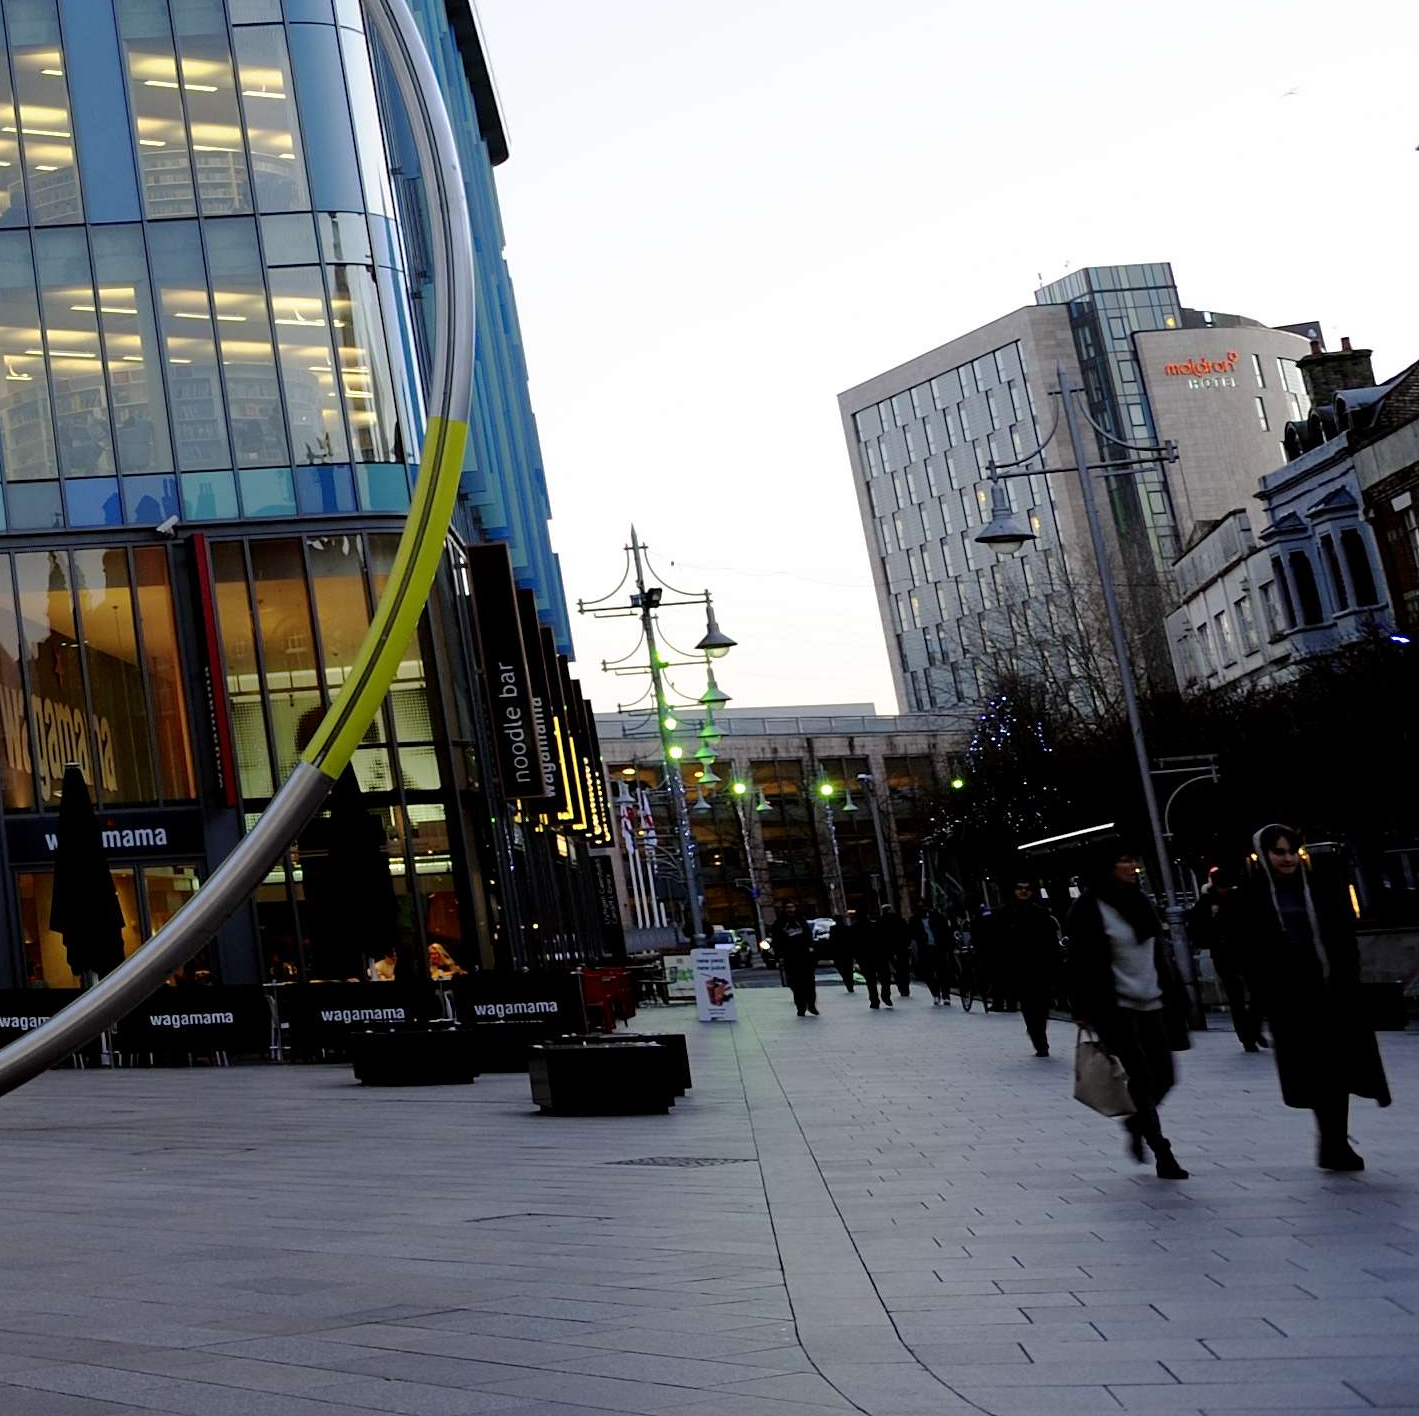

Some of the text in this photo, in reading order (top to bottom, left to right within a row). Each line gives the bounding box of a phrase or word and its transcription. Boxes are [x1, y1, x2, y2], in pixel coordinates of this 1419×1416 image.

[1188, 376, 1237, 390] HOTEL
[498, 661, 518, 699] bar
[505, 704, 532, 785] noodle
[321, 1006, 406, 1025] wagamama
[474, 1000, 559, 1018] wagamama
[149, 1011, 235, 1030] wagamama
